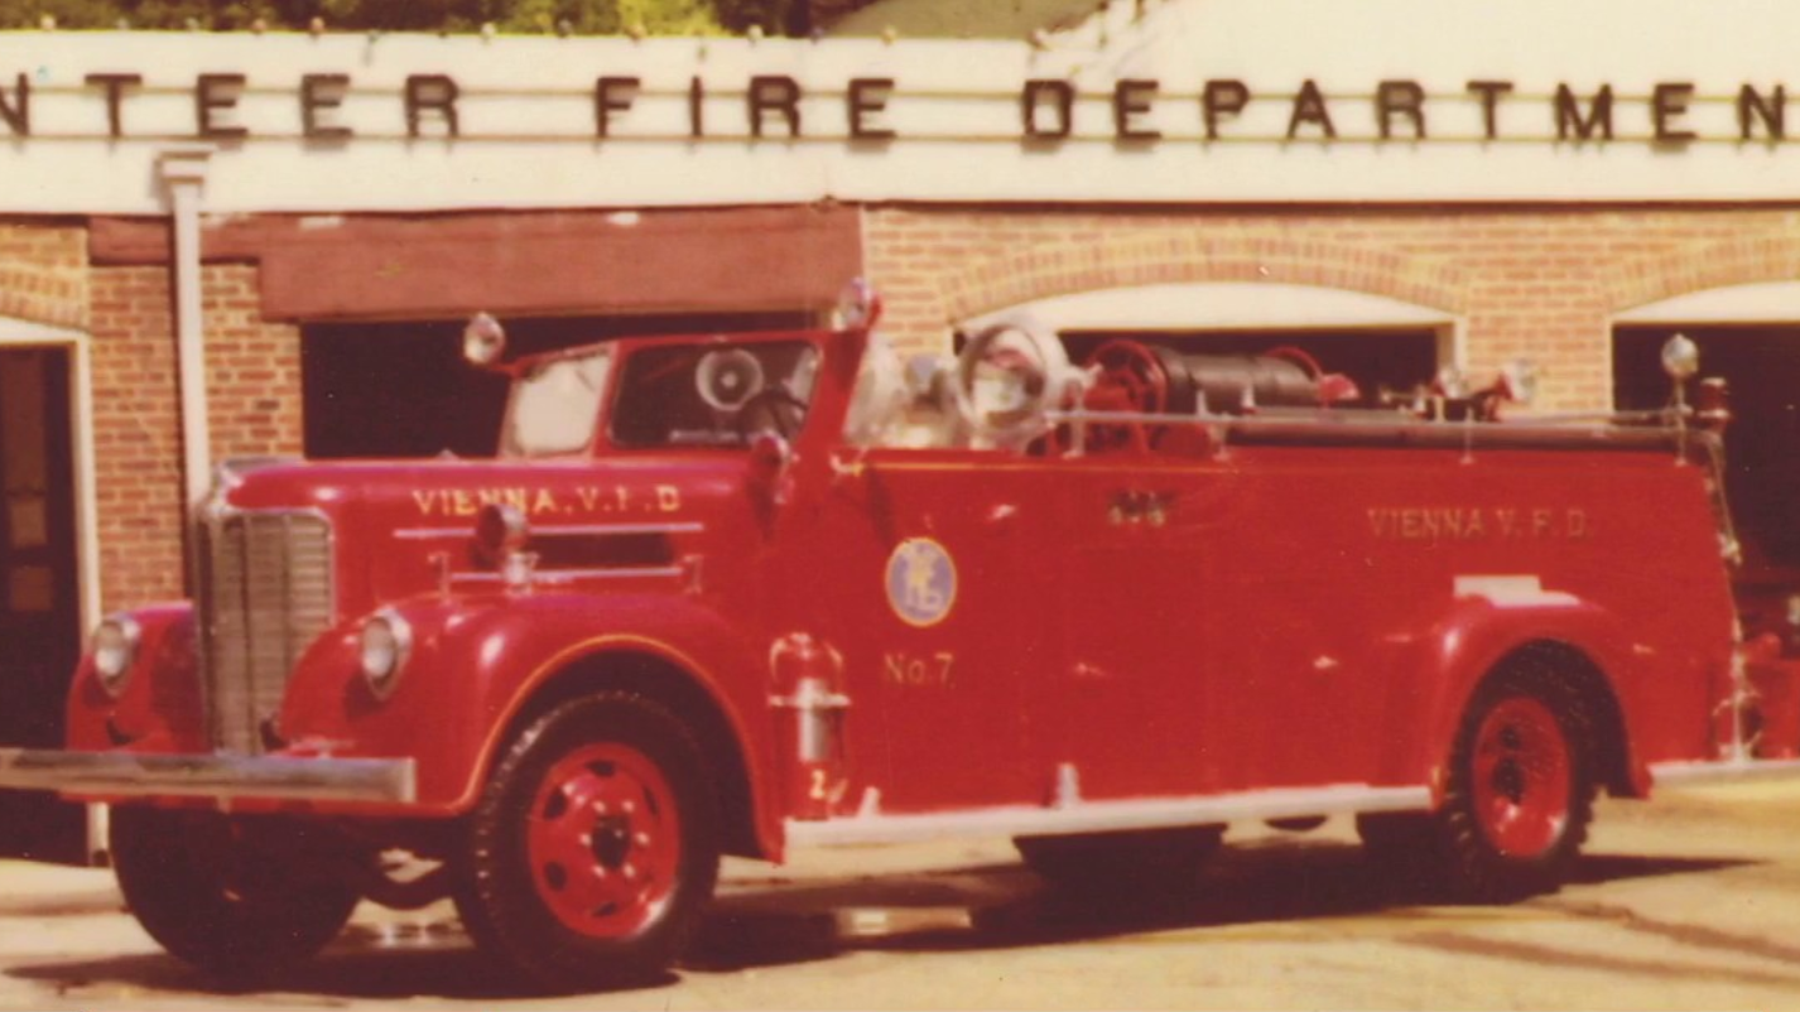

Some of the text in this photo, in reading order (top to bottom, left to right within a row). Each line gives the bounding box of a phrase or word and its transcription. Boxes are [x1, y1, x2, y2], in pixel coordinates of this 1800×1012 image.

[0, 73, 1786, 142] NTEER FIRE DEPARTMEN
[1367, 507, 1487, 539] VIENNA
